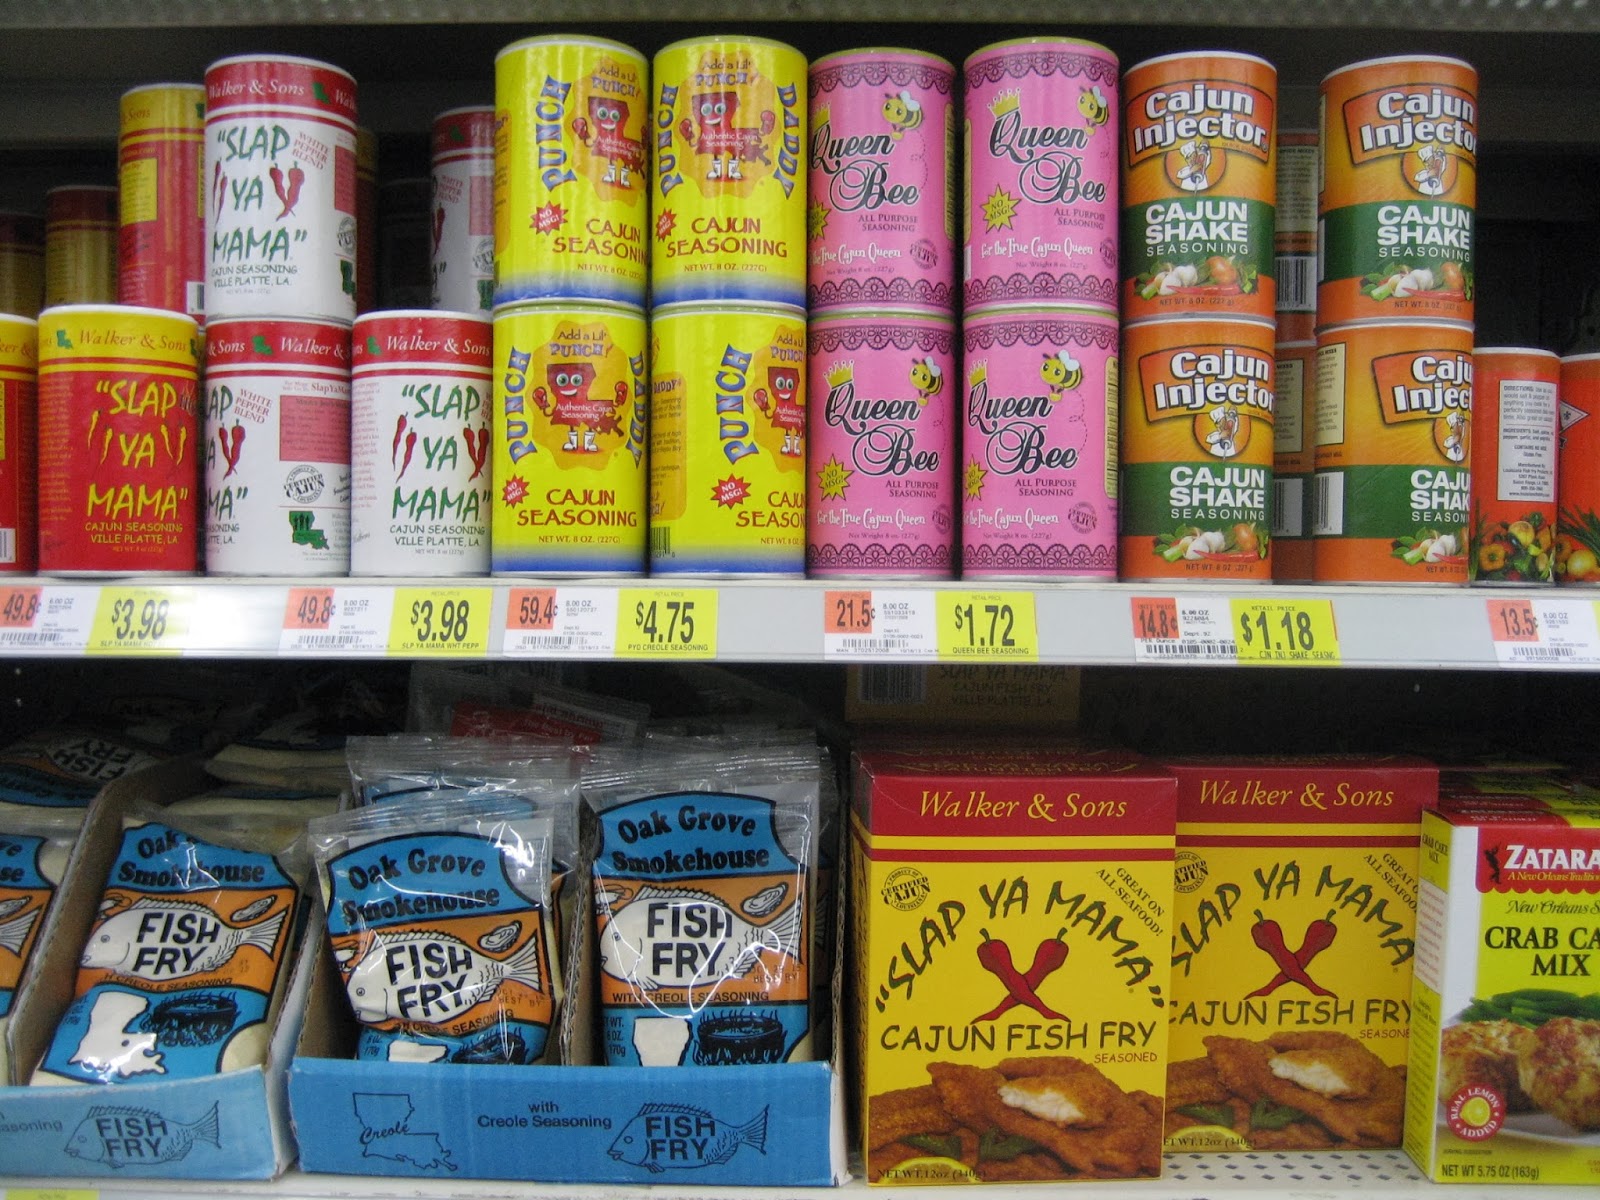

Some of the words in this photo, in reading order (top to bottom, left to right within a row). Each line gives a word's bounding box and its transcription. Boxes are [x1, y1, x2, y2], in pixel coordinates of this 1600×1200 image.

[249, 82, 266, 94] &
[269, 80, 305, 97] Sons
[1146, 83, 1254, 120] Cajun
[1378, 88, 1474, 124] Cajun
[536, 74, 577, 192] PUNCH
[658, 82, 684, 198] PUNCH
[773, 82, 800, 200] DADDY
[990, 108, 1088, 163] Queen
[1134, 112, 1267, 154] Injector
[811, 122, 894, 174] Queen
[830, 158, 920, 212] Bee
[1018, 151, 1106, 204] Bee
[232, 175, 264, 212] YA
[858, 214, 876, 222] ALL
[878, 214, 918, 224] PURPOSE
[1146, 202, 1248, 224] CAJUN
[1377, 205, 1471, 230] CAJUN
[586, 219, 640, 243] CAJUN
[691, 217, 760, 234] CAJUN
[862, 223, 915, 232] SEASONING
[1145, 222, 1248, 245] SHAKE
[666, 237, 787, 258] SEASONING
[1006, 238, 1028, 256] True
[1030, 236, 1061, 260] Cajun
[1064, 237, 1094, 260] Queen
[1146, 242, 1248, 257] SEASONING
[1377, 226, 1470, 250] SHAKE
[1378, 246, 1470, 262] SEASONING
[80, 330, 136, 346] Walker
[140, 334, 156, 350] &
[160, 335, 188, 352] Sons
[218, 340, 246, 354] Sons
[387, 335, 440, 351] Walker
[444, 337, 459, 355] &
[462, 338, 490, 356] Sons
[557, 330, 582, 340] Add
[583, 332, 590, 340] a
[280, 337, 331, 355] Walker
[333, 343, 345, 360] &
[1170, 350, 1270, 381] Cajun
[504, 346, 538, 465] PUNCH
[556, 403, 591, 412] Authentic
[626, 350, 646, 470] DADDY
[715, 343, 760, 466] PUNCH
[824, 382, 922, 436] Queen
[967, 381, 1053, 435] Queen
[561, 412, 600, 422] Seasoning
[119, 433, 155, 468] YA
[424, 435, 458, 472] YA
[852, 424, 940, 476] Bee
[986, 421, 1078, 476] Bee
[722, 482, 736, 492] NO
[1015, 478, 1034, 488] ALL
[1036, 478, 1077, 488] PURPOSE
[1170, 466, 1265, 488] CAJUN
[546, 488, 615, 506] CAJUN
[720, 488, 743, 503] MSG!
[1018, 488, 1074, 496] SEASONING
[1170, 488, 1264, 508] SHAKE
[517, 509, 637, 527] SEASONING
[1170, 508, 1265, 521] SEASONING
[85, 522, 122, 532] CAJUN
[126, 522, 183, 533] SEASONING
[91, 535, 121, 543] VILLE
[390, 525, 424, 534] CAJUN
[428, 525, 486, 536] SEASONING
[538, 535, 554, 544] NET
[395, 537, 424, 546] VILLE
[112, 597, 170, 640] $3.98
[411, 600, 470, 642] $3.98
[636, 600, 695, 644] $4.75
[954, 604, 1016, 647] $1.72
[1240, 611, 1314, 650] $1.18
[920, 790, 1020, 818] Walker
[1027, 793, 1057, 822] &
[1063, 793, 1128, 818] Sons
[1200, 780, 1293, 806] Walker
[1300, 782, 1328, 810] &
[1334, 782, 1394, 806] Sons
[618, 810, 672, 844] Oak
[678, 806, 756, 836] Grove
[349, 855, 402, 890] Oak
[408, 848, 486, 876] Grove
[612, 848, 770, 874] Smokehouse
[1116, 866, 1149, 900] GREAT
[1148, 900, 1165, 918] ON
[1254, 860, 1300, 900] YA
[342, 888, 500, 926] Smokehouse
[979, 876, 1029, 919] YA
[1096, 867, 1116, 888] ALL
[1114, 886, 1165, 938] SEAFOOD!
[1505, 900, 1538, 914] New
[1540, 900, 1588, 914] Orleans
[136, 912, 221, 944] FISH
[647, 902, 732, 938] FISH
[1484, 926, 1558, 950] CRAB
[133, 946, 209, 975] FRY
[386, 943, 473, 986] FISH
[652, 942, 726, 978] FRY
[1531, 954, 1591, 976] MIX
[397, 974, 469, 1020] FRY
[612, 992, 642, 1002] WITH
[648, 992, 694, 1002] CREOLE
[698, 991, 769, 1002] SEASONING
[1278, 1000, 1354, 1026] FISH
[880, 1024, 995, 1052] CAJUN
[1007, 1022, 1088, 1052] FISH
[1100, 1020, 1157, 1048] FRY
[1094, 1052, 1158, 1064] SEASONED
[528, 1101, 560, 1114] with
[1450, 1093, 1466, 1122] REAL
[1466, 1086, 1500, 1108] LEMON
[96, 1118, 168, 1138] FISH
[360, 1124, 410, 1145] Creole
[478, 1114, 529, 1128] Creole
[532, 1114, 613, 1132] Seasoning
[644, 1116, 716, 1138] FISH
[1460, 1121, 1498, 1138] ADDED
[104, 1138, 162, 1158] FRY
[650, 1138, 710, 1160] FRY
[1442, 1166, 1460, 1178] NET
[1462, 1166, 1475, 1178] WT
[1477, 1166, 1497, 1178] 5.75
[1498, 1166, 1510, 1178] OZ
[1512, 1165, 1540, 1180] (163g)
